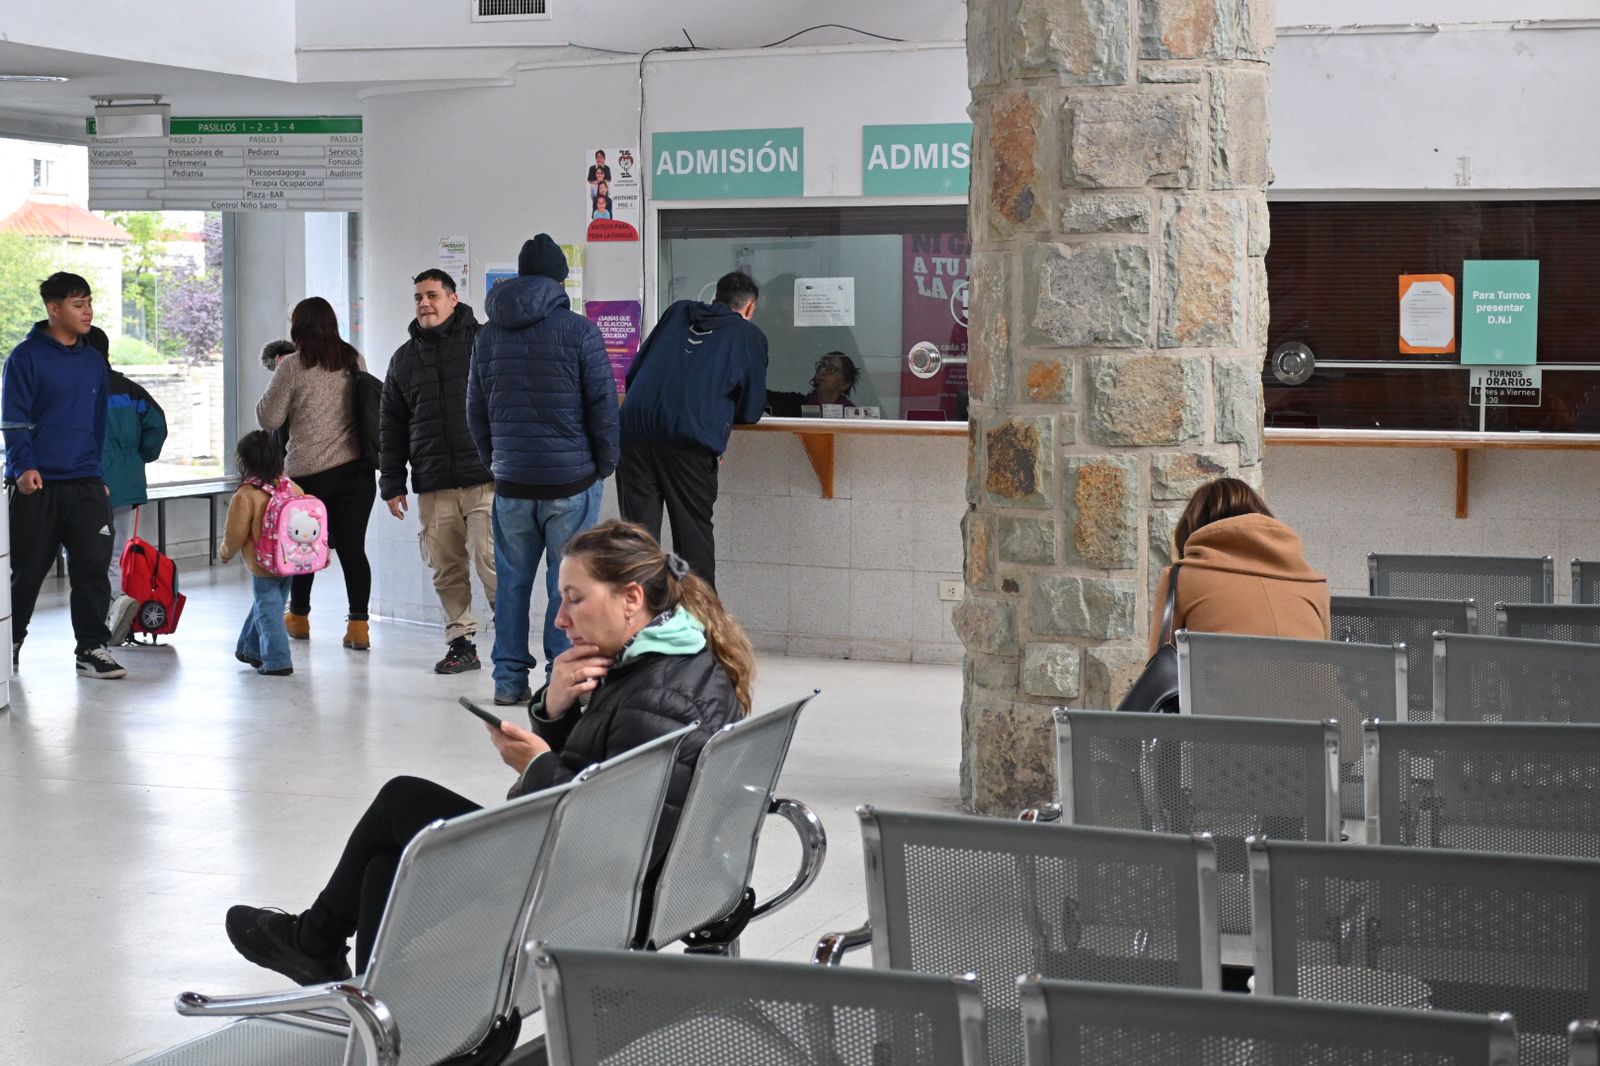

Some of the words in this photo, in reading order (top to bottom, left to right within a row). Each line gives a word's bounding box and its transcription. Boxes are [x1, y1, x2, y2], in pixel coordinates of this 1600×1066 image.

[198, 123, 236, 132] PASILLOS
[257, 123, 263, 132] 2
[273, 123, 279, 132] 3
[289, 123, 294, 131] 4
[329, 148, 357, 156] Servicio
[867, 142, 970, 170] ADMIS
[656, 140, 798, 175] ADMISIÓN
[279, 180, 324, 188] Ocupacional
[212, 201, 238, 209] Control
[259, 201, 277, 209] Sano
[913, 256, 928, 274] A
[931, 257, 960, 276] TU
[914, 275, 948, 299] LA
[1473, 291, 1495, 300] Para
[1497, 291, 1531, 300] Turnos
[1476, 303, 1524, 314] presentar
[1488, 315, 1511, 325] D.N.I
[1488, 370, 1523, 378] TURNOS
[1474, 388, 1498, 396] Lnes
[1506, 388, 1536, 396] Viernes
